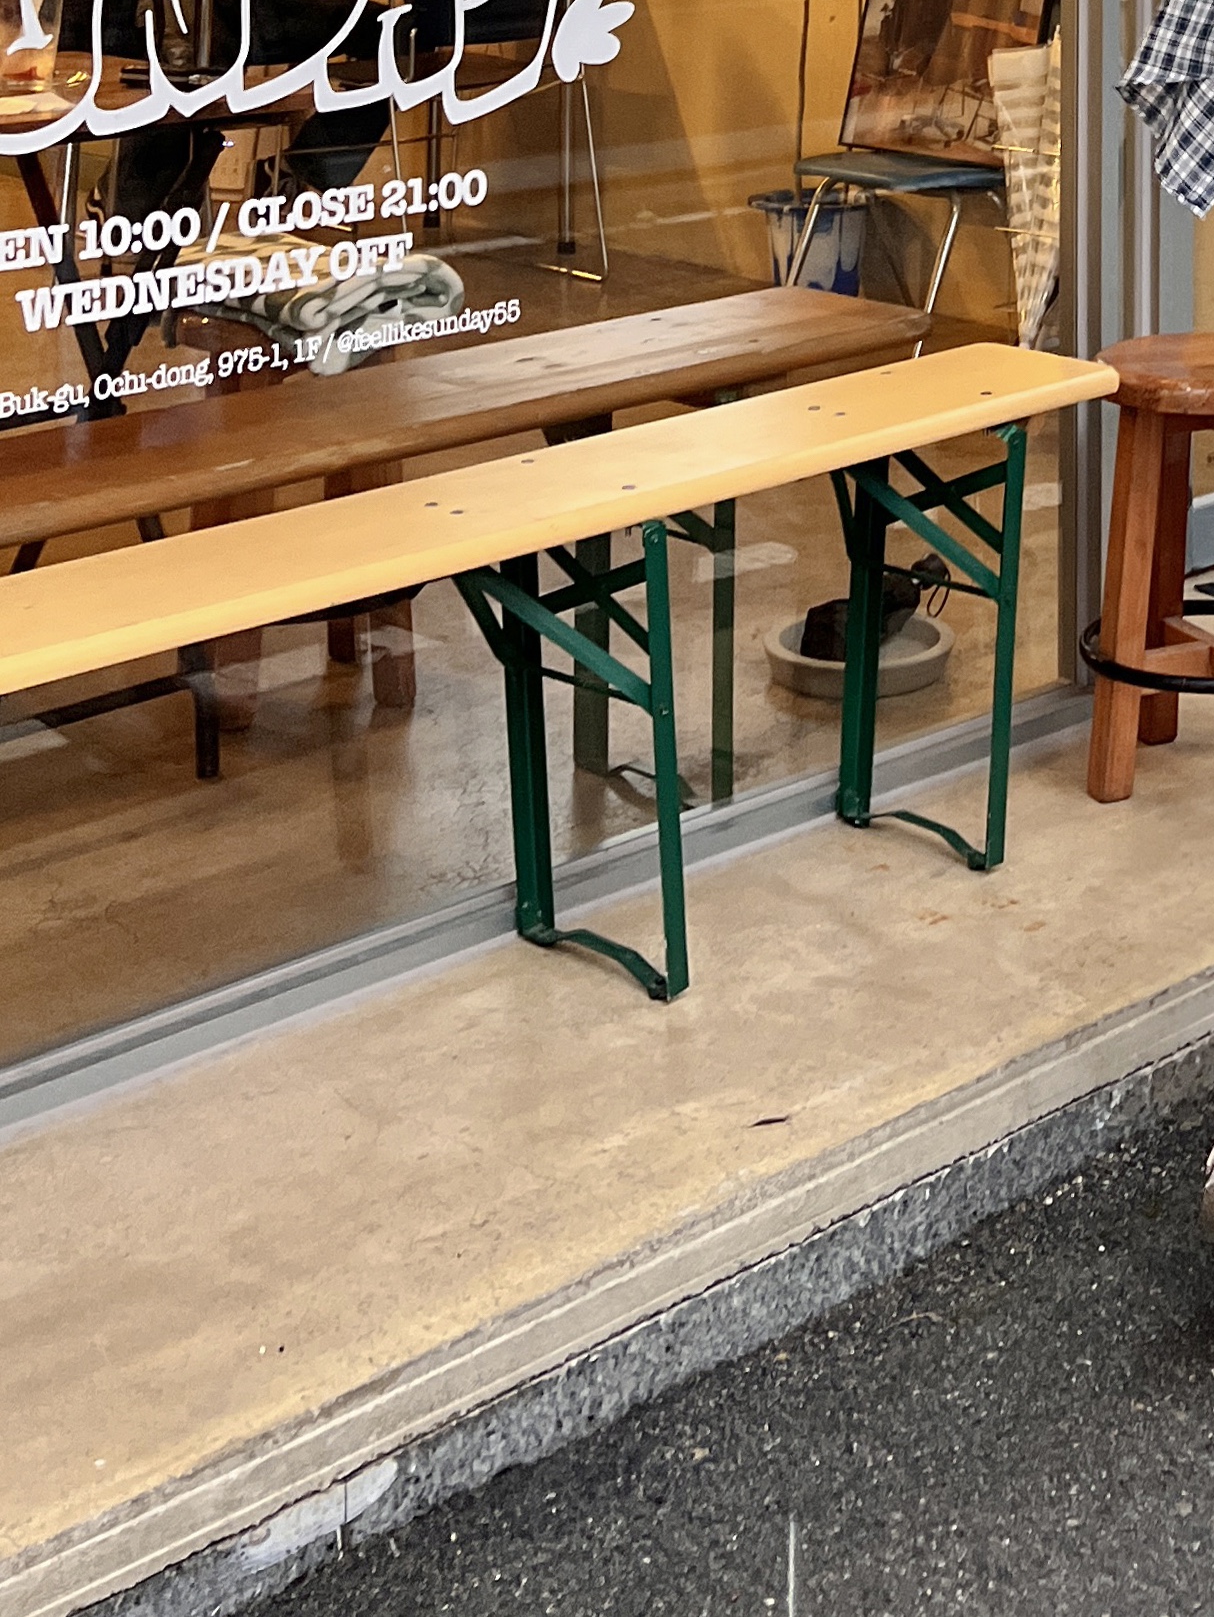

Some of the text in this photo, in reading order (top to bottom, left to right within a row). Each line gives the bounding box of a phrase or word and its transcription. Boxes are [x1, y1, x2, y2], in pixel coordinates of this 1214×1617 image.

[79, 206, 200, 261] 10:00
[238, 184, 375, 238] CLOSE
[380, 168, 488, 220] 21:00
[15, 232, 414, 333] WEDNESDAY OFF
[218, 344, 289, 379] 975-1,
[293, 335, 323, 365] 1F
